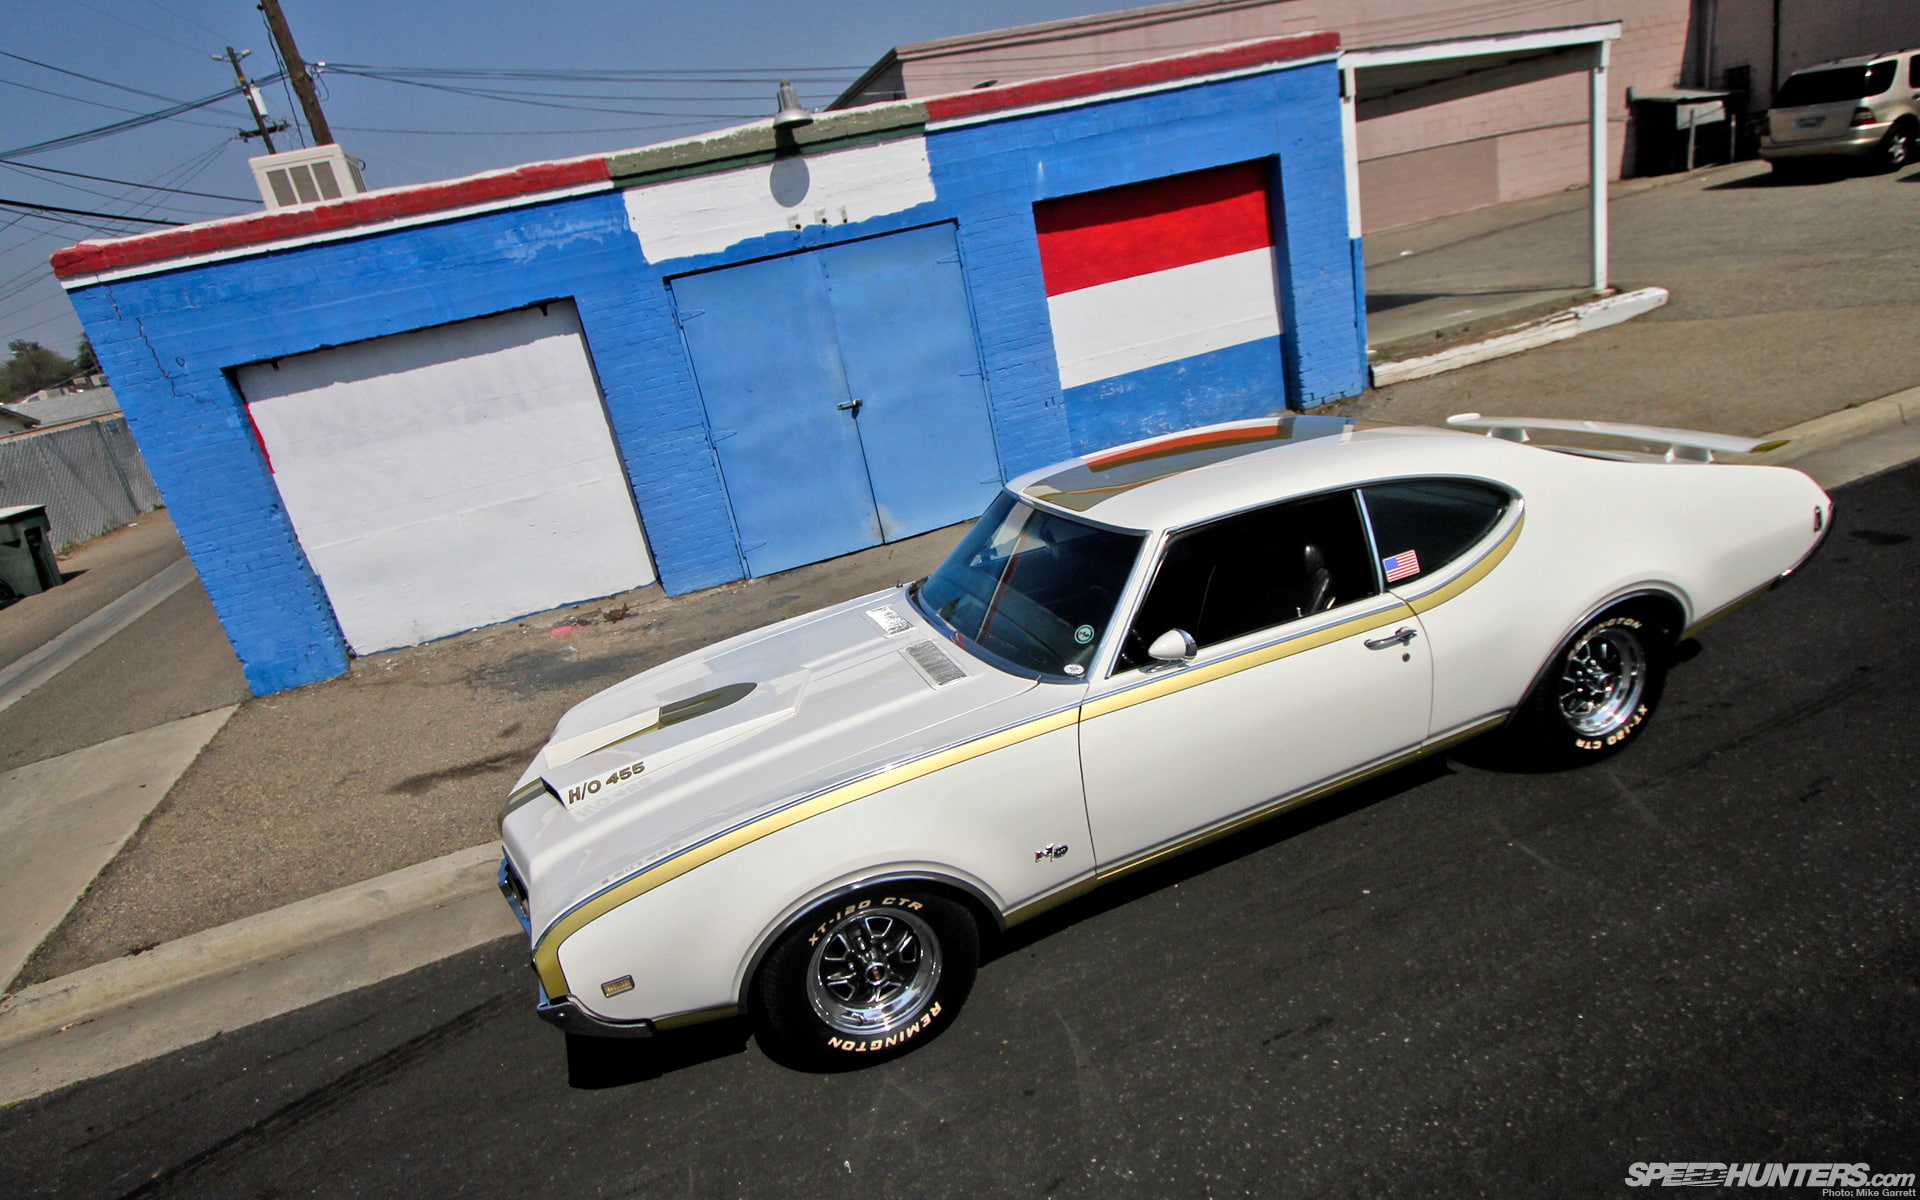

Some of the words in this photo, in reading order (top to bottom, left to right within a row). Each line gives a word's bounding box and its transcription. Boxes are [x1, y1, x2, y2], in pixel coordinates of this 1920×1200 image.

[1575, 739, 1603, 750] CTR
[568, 779, 602, 805] H/O
[605, 761, 646, 785] 455
[808, 900, 872, 947] XT-120
[881, 897, 924, 911] CTR
[827, 1001, 943, 1052] REMINGTON
